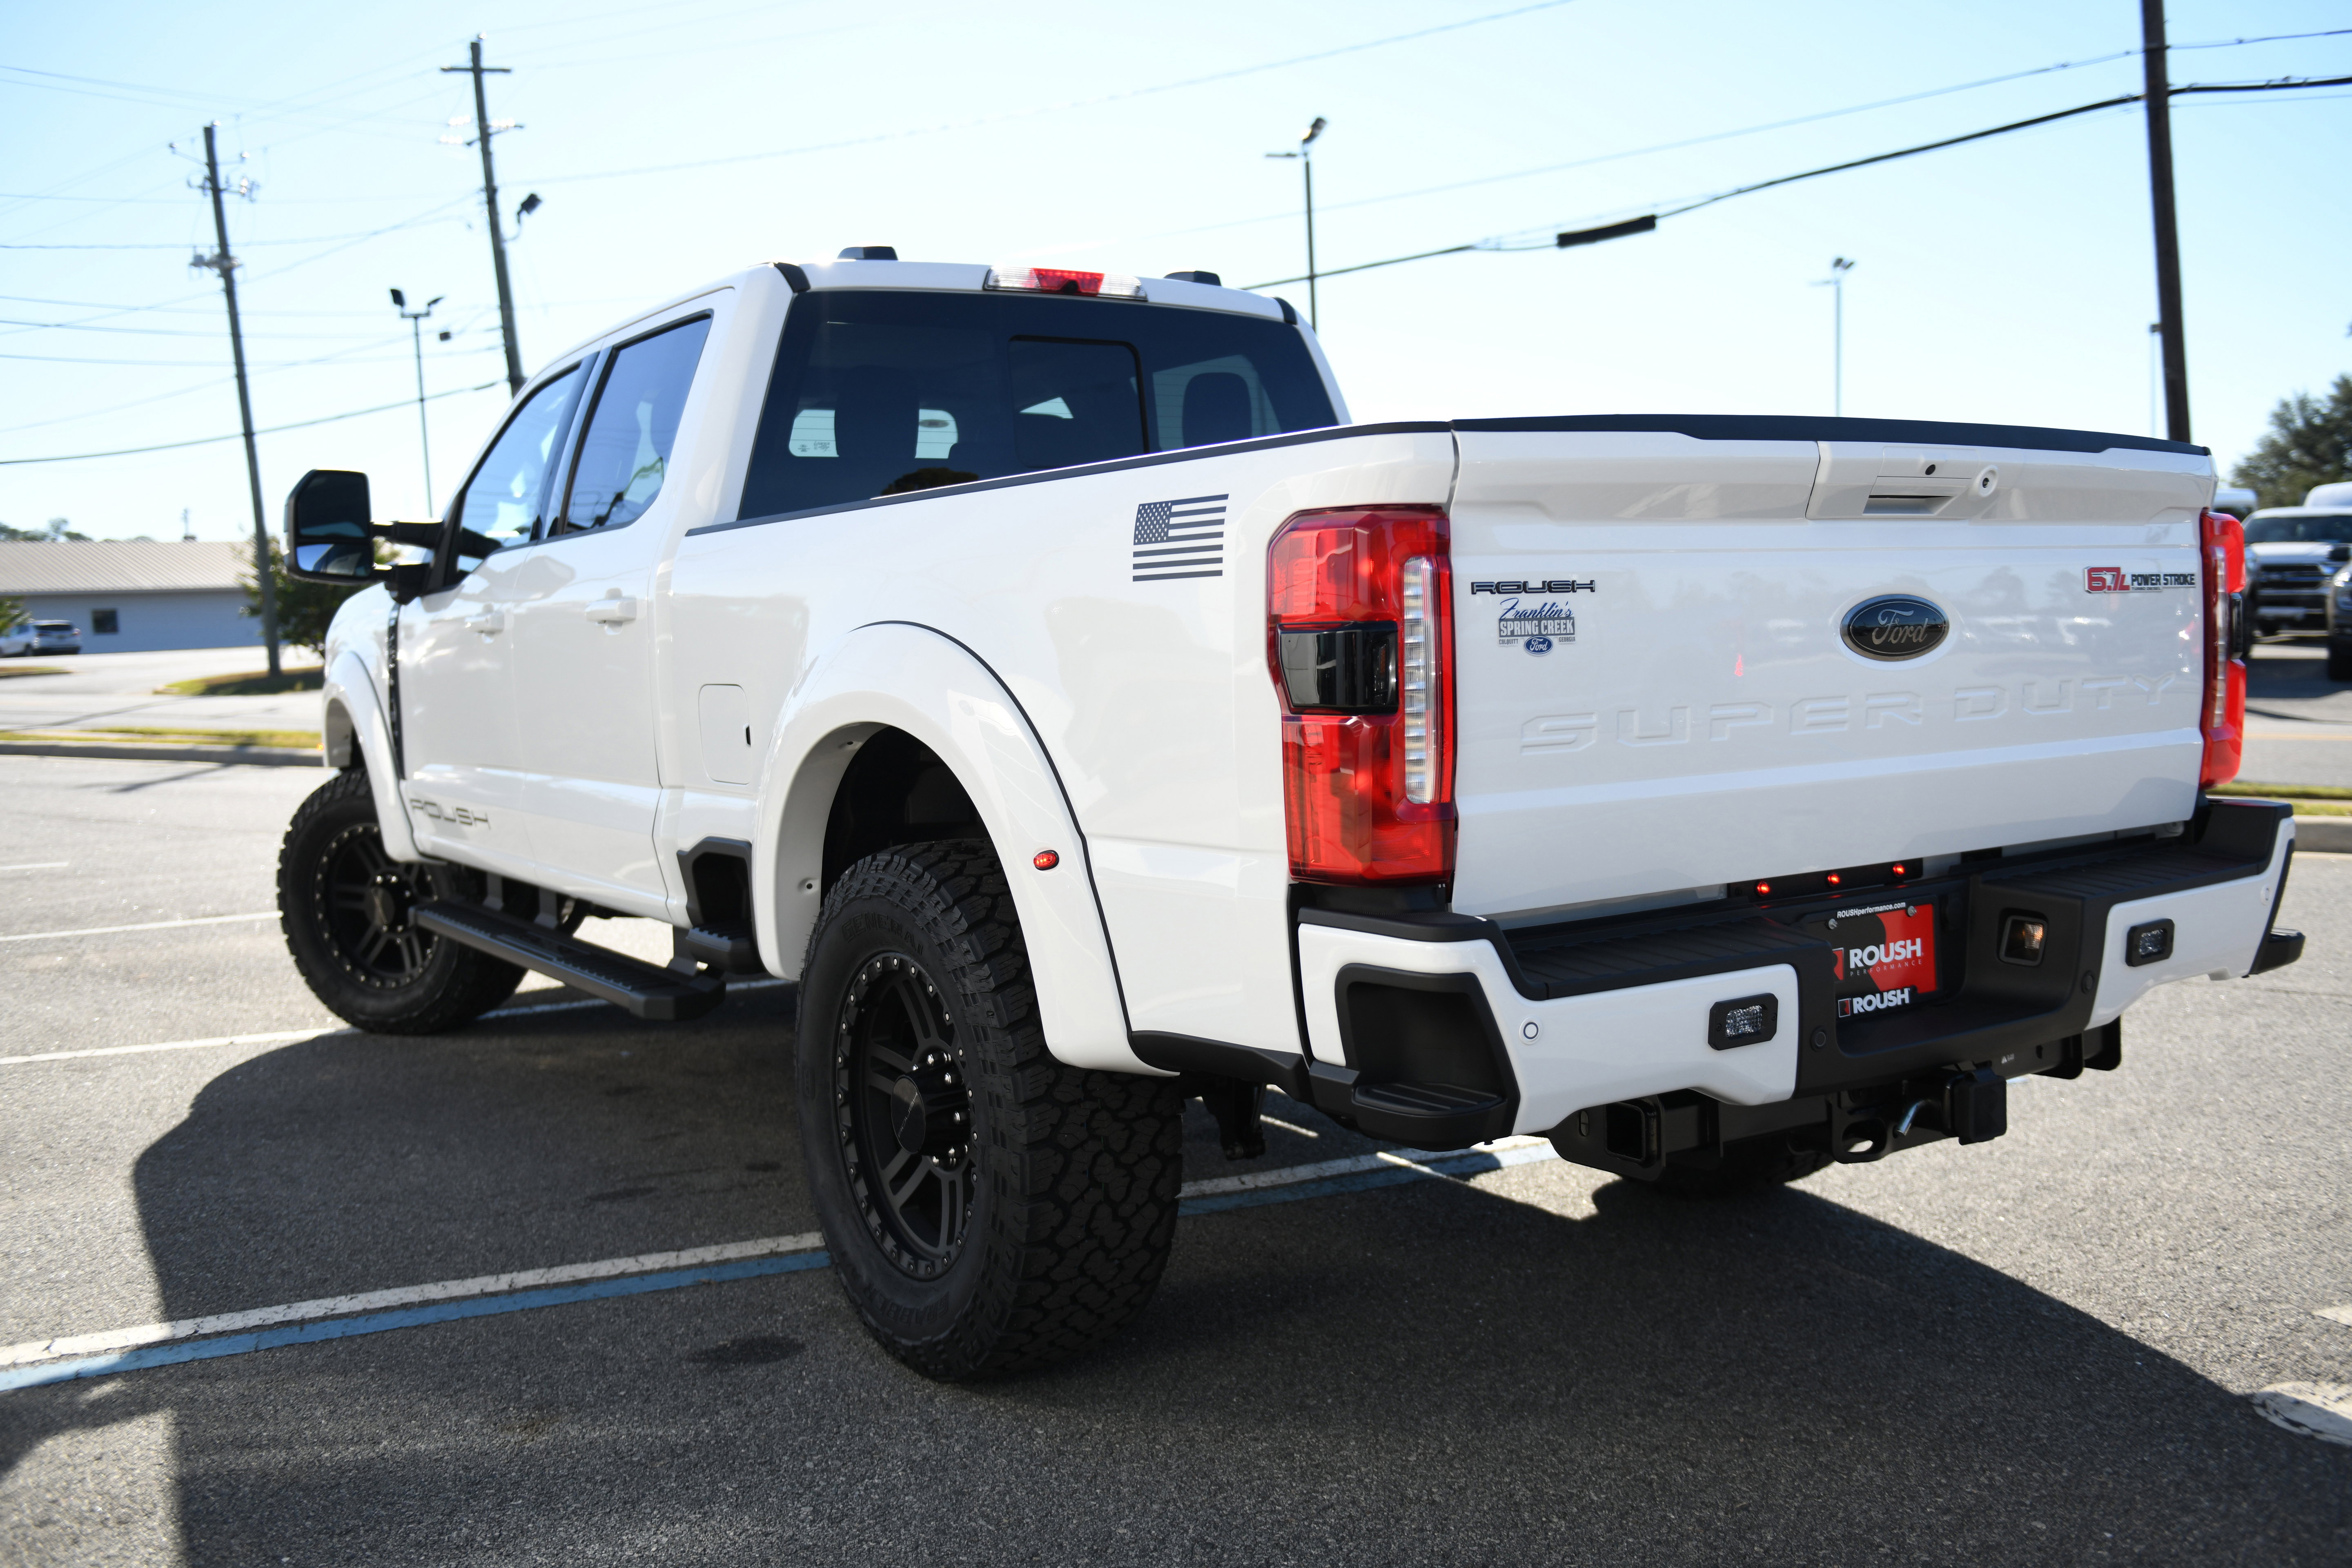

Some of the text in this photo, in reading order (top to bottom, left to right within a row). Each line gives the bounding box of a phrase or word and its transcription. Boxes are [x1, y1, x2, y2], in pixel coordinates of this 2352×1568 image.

[1471, 580, 1595, 595] ROUSH
[2131, 574, 2162, 586] POWER
[2163, 573, 2195, 586] STROKE
[1500, 597, 1574, 621] Franklin's
[1500, 619, 1574, 636] SPRING CREEK
[1872, 608, 1929, 645] Ford
[1530, 638, 1548, 651] Ford
[1520, 672, 2176, 756] SUPER DUTY
[1837, 902, 1906, 918] ROUSHperformance.com
[1849, 938, 1921, 969] ROUSH
[1850, 958, 1922, 977] PERFORMANCE
[1852, 987, 1910, 1014] ROUSH
